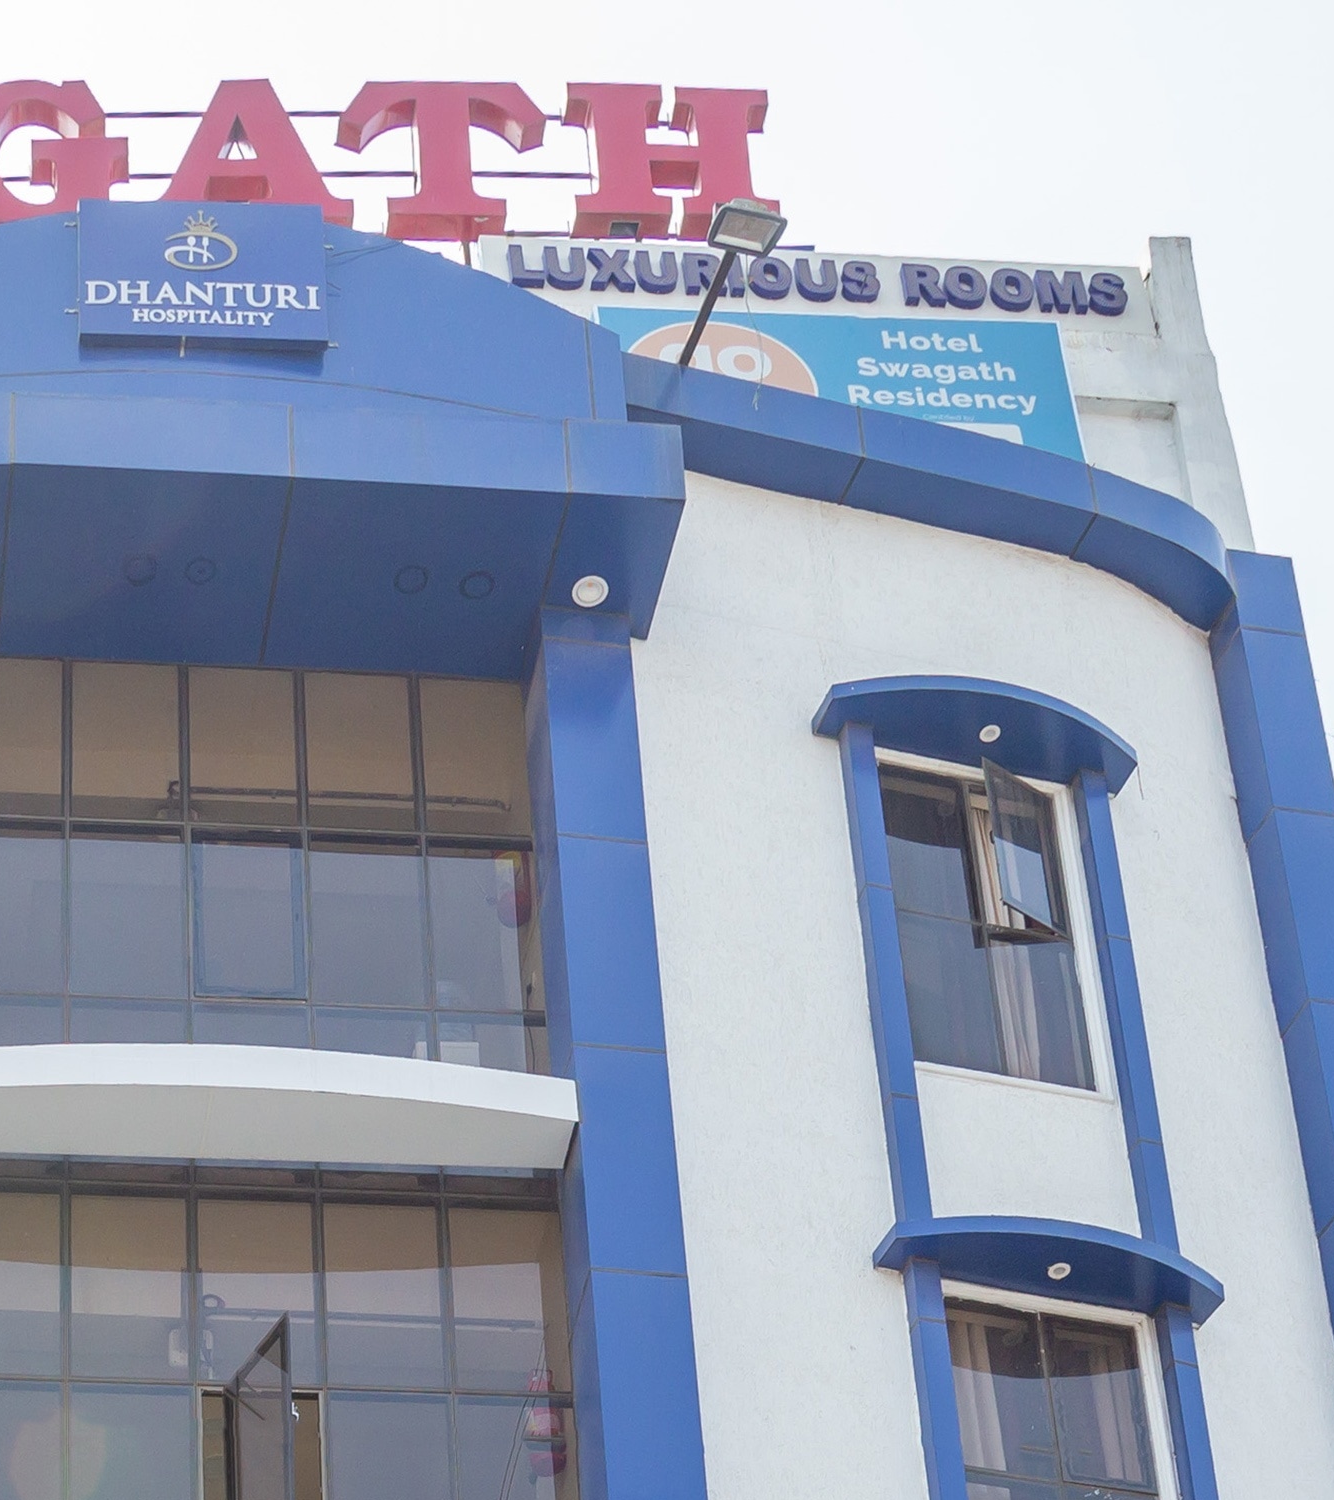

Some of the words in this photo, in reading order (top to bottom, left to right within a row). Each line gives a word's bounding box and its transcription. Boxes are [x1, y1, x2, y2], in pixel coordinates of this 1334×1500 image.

[84, 280, 321, 310] DHANTURI
[506, 244, 880, 304] LUXURIOUS
[899, 262, 1129, 317] ROOMS
[132, 308, 274, 326] HOSPITALITY
[881, 330, 983, 353] Hotel
[856, 356, 1017, 385] Swagath
[847, 384, 1037, 416] Residency
